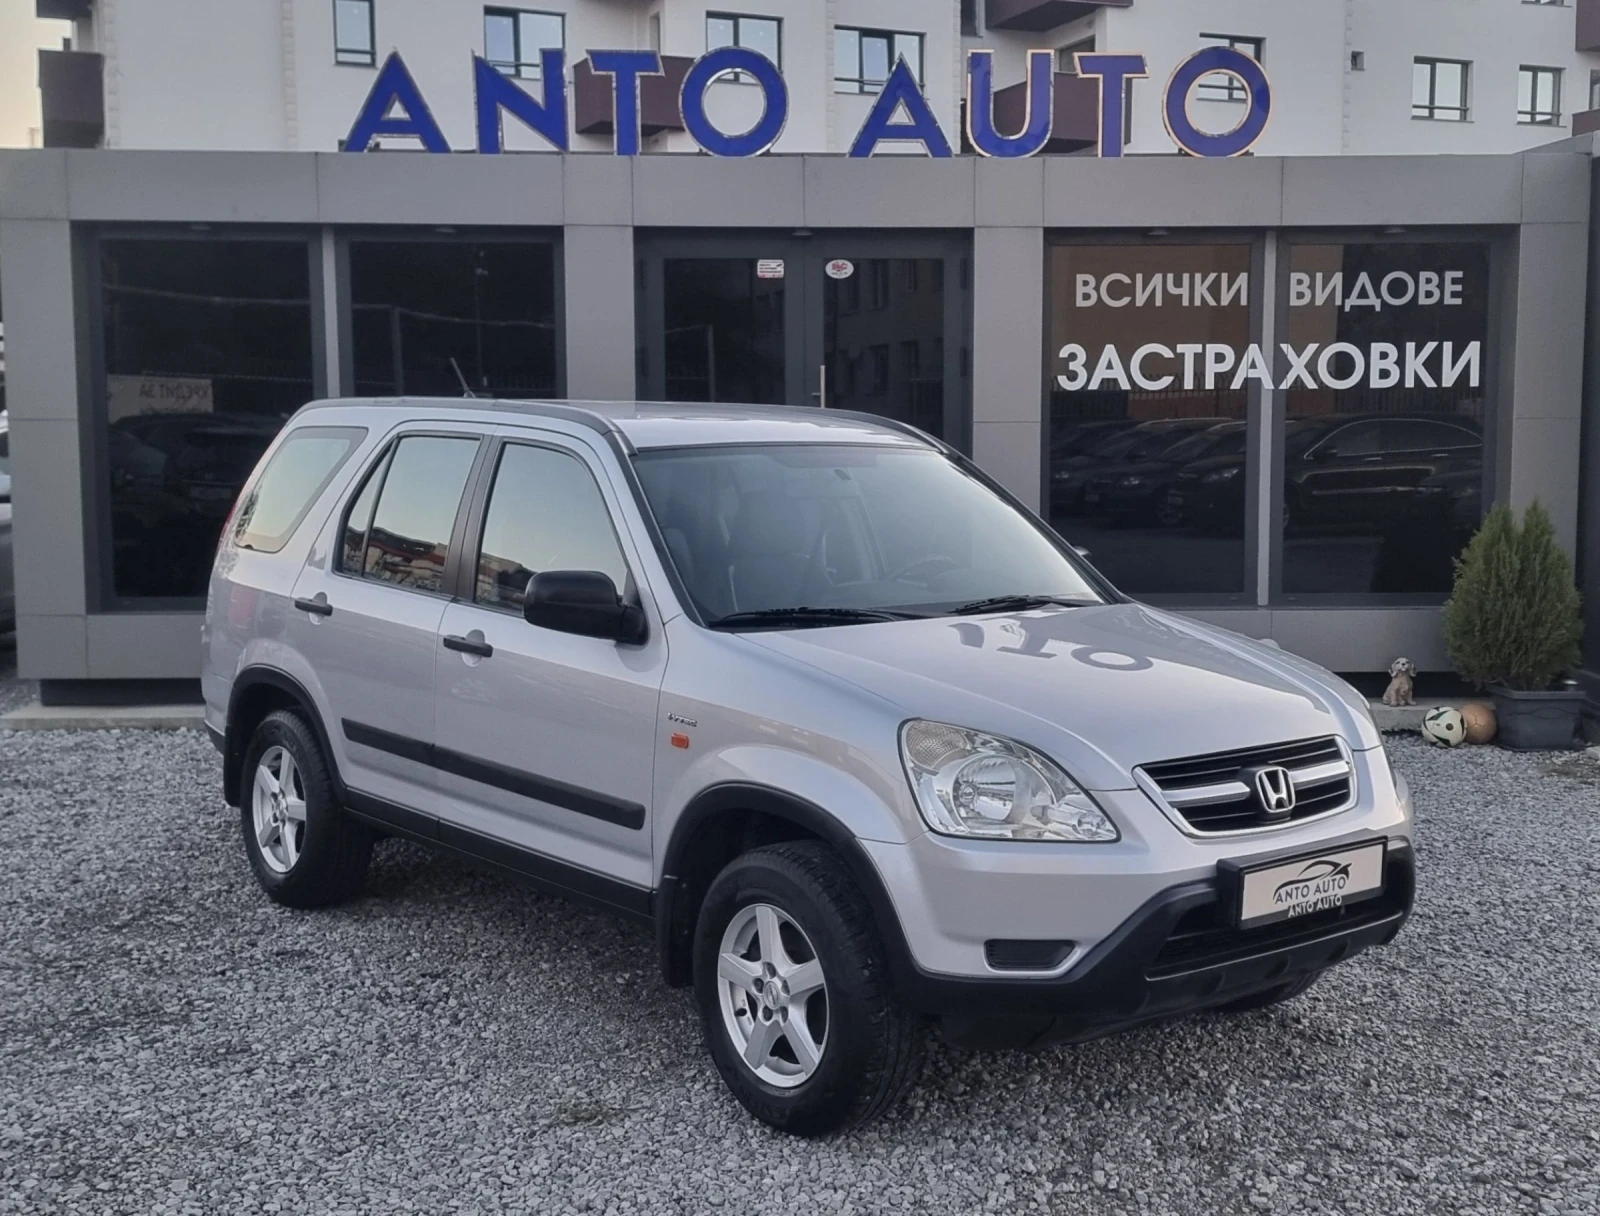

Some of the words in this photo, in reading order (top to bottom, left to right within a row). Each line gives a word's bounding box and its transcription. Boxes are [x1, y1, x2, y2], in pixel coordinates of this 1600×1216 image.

[339, 46, 789, 157] ANTO
[846, 45, 1273, 158] AUTO
[1075, 272, 1249, 307] ВСИЧКИ
[1289, 270, 1464, 312] ВИДОВЕ
[1056, 340, 1481, 391] ЗАСТРАХОВКИ
[1275, 884, 1310, 904] ANTO
[1313, 876, 1347, 895] AUTO
[1287, 901, 1314, 919] ANTO
[1316, 894, 1343, 911] AUTO
